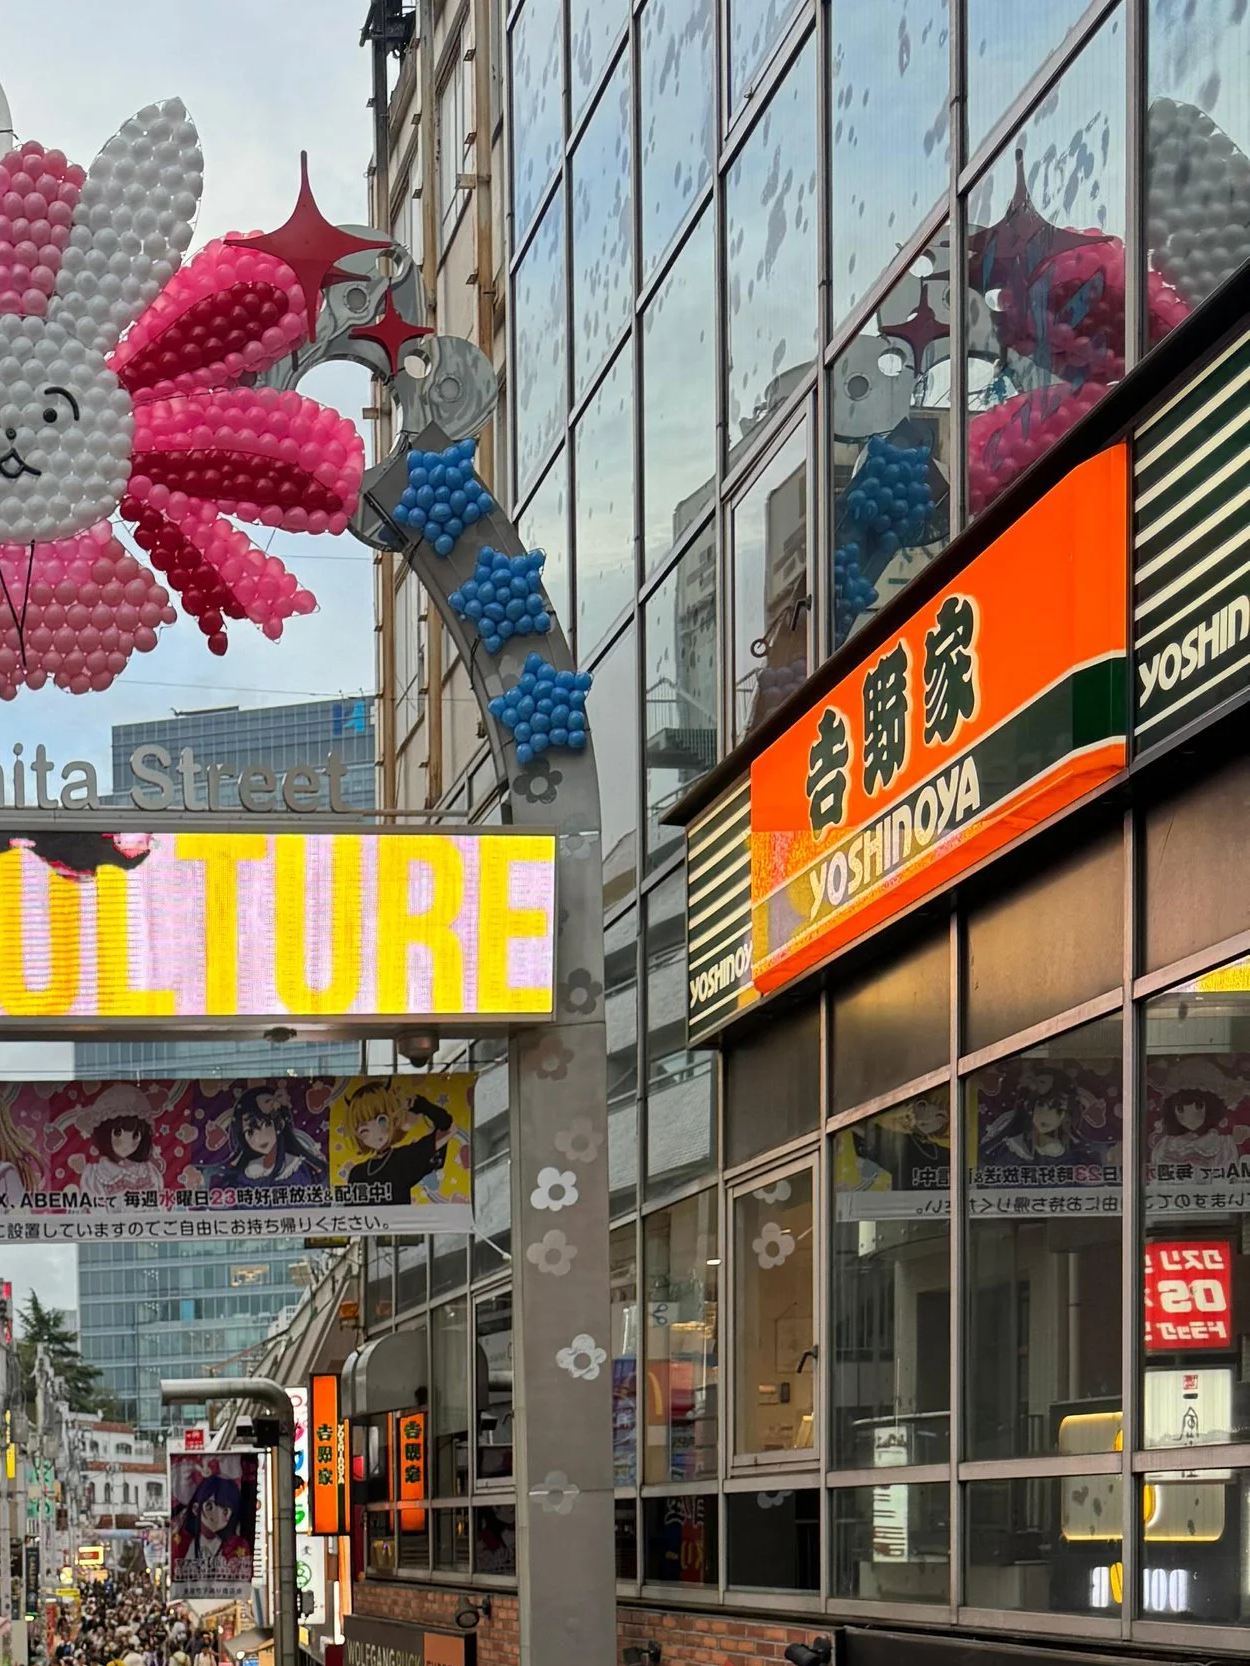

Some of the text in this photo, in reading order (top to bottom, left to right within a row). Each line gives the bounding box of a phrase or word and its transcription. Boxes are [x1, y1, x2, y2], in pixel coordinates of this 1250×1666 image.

[130, 744, 350, 813] Street
[807, 597, 976, 840] 吉野家
[810, 756, 980, 922] YOSHINOYA
